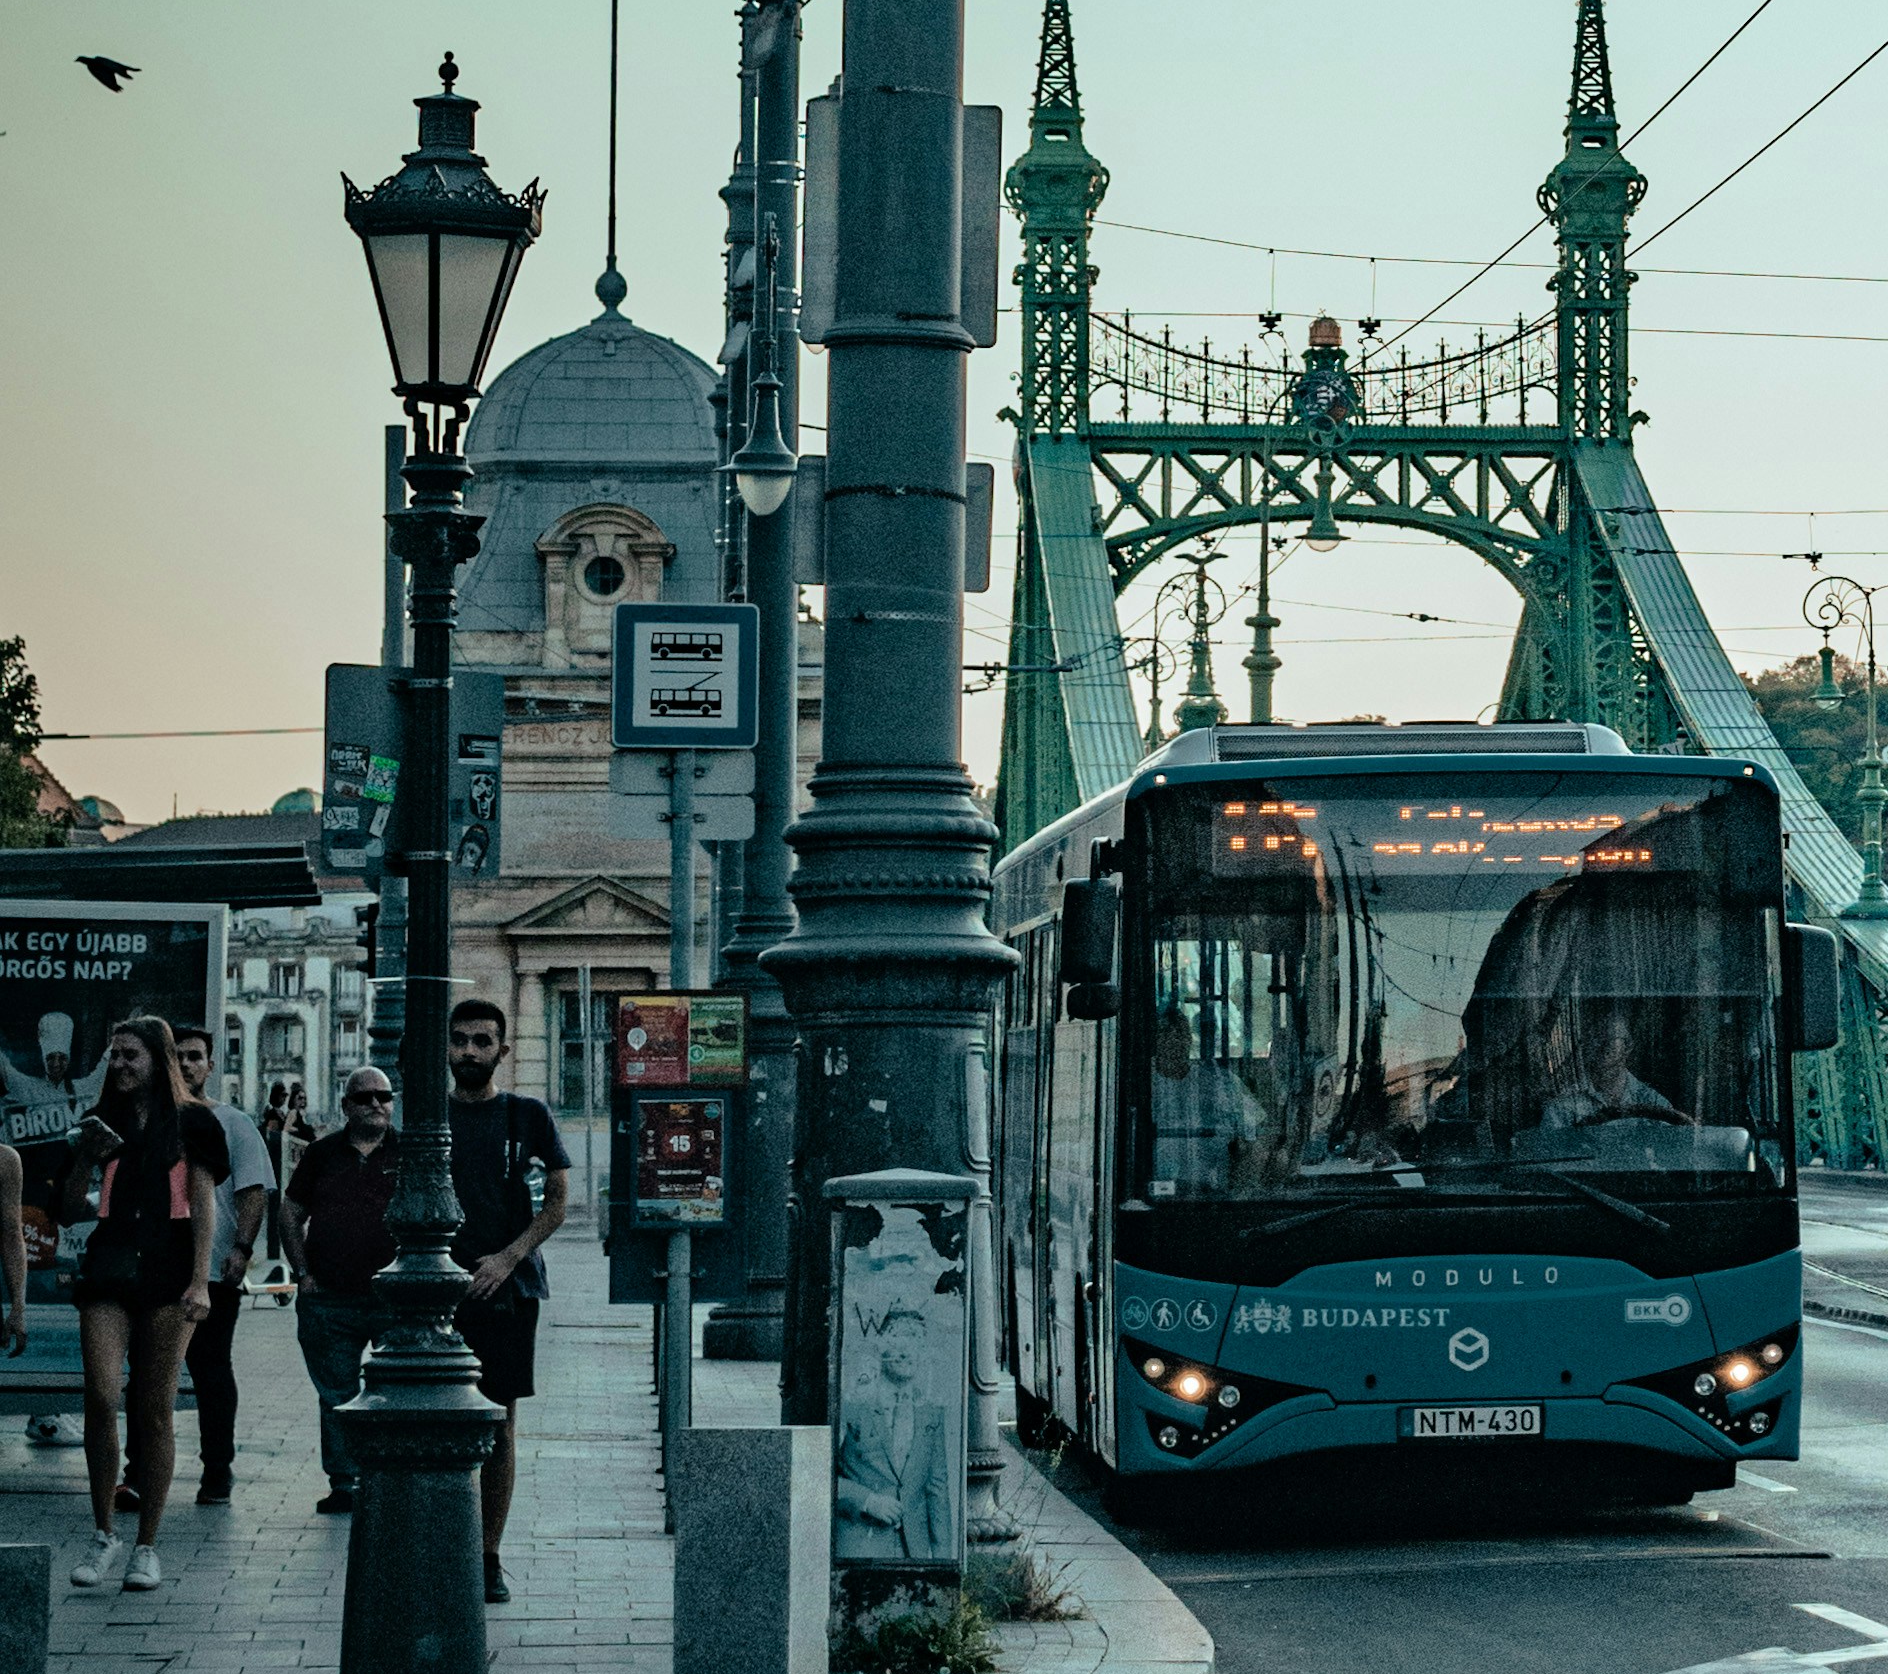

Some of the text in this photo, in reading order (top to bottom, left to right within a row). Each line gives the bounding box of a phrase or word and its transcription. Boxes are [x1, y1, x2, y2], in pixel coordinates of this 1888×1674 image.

[27, 932, 69, 951] EGY
[77, 929, 147, 956] ÚJABB
[73, 961, 132, 981] NAP?
[669, 1135, 691, 1153] 15
[1375, 1266, 1559, 1288] MODULO
[1302, 1308, 1450, 1328] BUDAPEST
[1633, 1306, 1661, 1315] BKK
[1420, 1409, 1534, 1434] NTM-430
